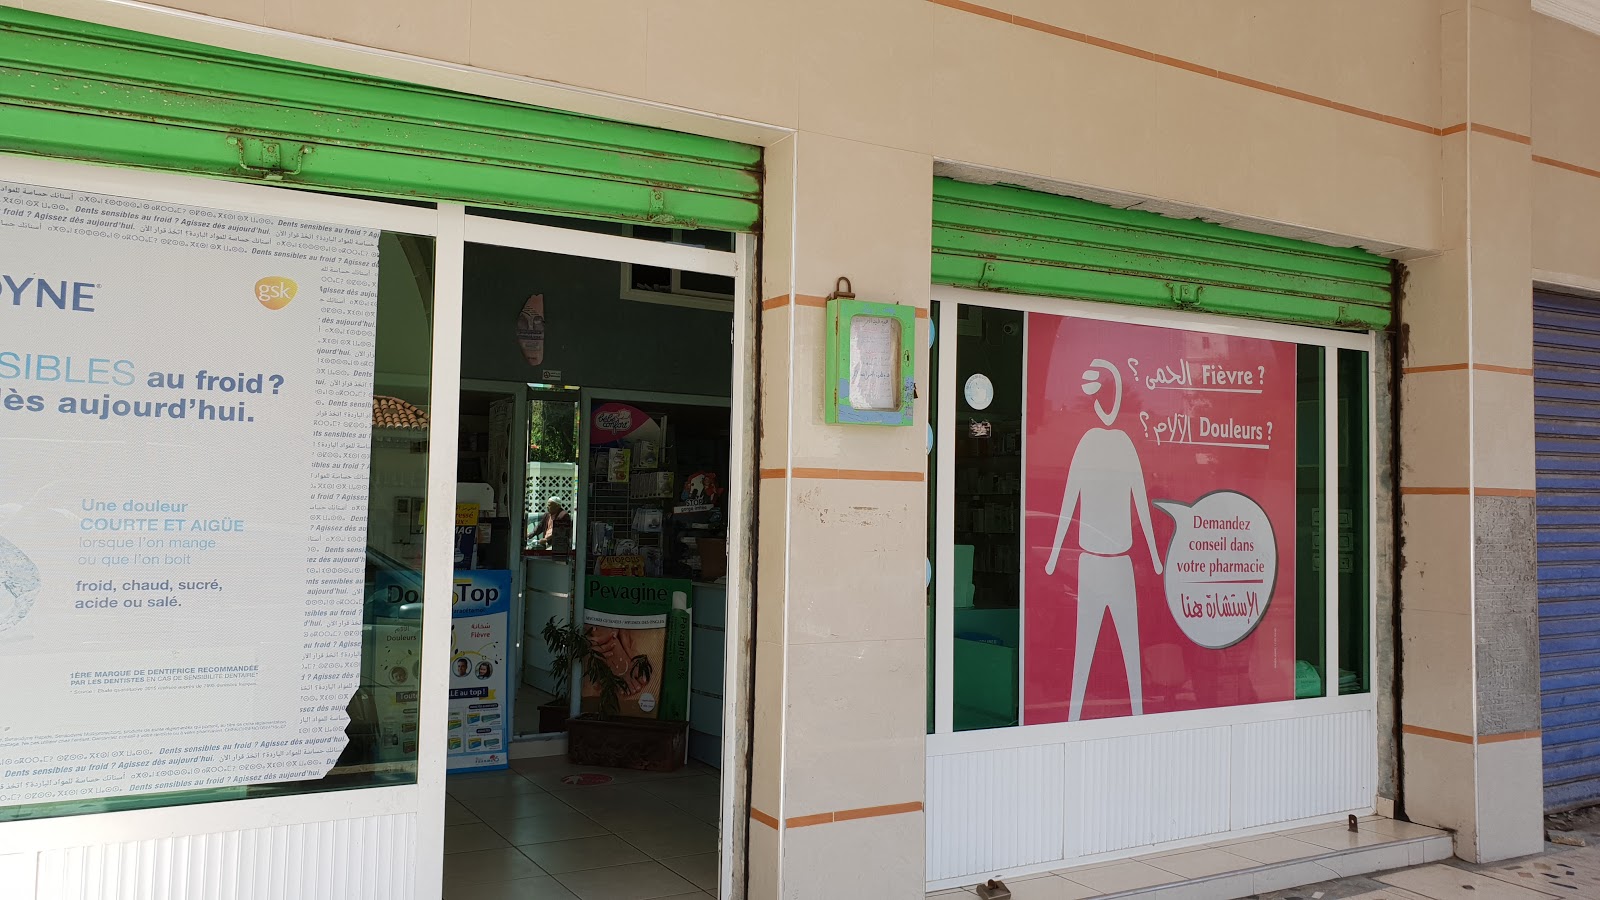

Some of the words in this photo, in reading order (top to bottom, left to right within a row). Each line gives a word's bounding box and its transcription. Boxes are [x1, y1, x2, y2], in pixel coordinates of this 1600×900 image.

[3, 208, 24, 217] froid
[34, 212, 67, 222] Agissez
[75, 205, 99, 215] Dents
[101, 210, 139, 220] sensibles
[153, 215, 173, 223] froid
[181, 218, 210, 228] Agissez
[277, 219, 298, 228] Dents
[300, 223, 333, 232] sensibles
[344, 228, 362, 236] froid
[252, 247, 272, 256] Dents
[273, 250, 307, 260] sensibles
[320, 255, 336, 263] froid
[344, 258, 370, 266] Agissez
[0, 275, 95, 312] YNE
[258, 282, 290, 302] gsk
[0, 351, 136, 387] SIBLES
[147, 371, 185, 389] au
[1202, 364, 1254, 385] Fièvre
[1257, 365, 1265, 385] ?
[0, 387, 45, 412] ès
[58, 394, 254, 422] aujourd'hui.
[1200, 416, 1264, 441] Douleurs
[1266, 421, 1273, 441] ?
[81, 499, 118, 512] Une
[122, 500, 188, 512] douleur
[80, 518, 159, 532] COURTE
[163, 519, 187, 531] ET
[190, 517, 244, 532] AIGÜE
[1193, 516, 1251, 530] Demandez
[79, 537, 134, 551] lorsque
[169, 539, 216, 550] mange
[1189, 537, 1228, 551] conseil
[1230, 537, 1254, 552] dans
[78, 556, 96, 566] ou
[101, 556, 130, 568] que
[164, 554, 192, 566] boit
[1177, 560, 1206, 573] votre
[1209, 558, 1265, 577] pharmacie
[76, 580, 117, 592] froid,
[122, 580, 174, 592] chaud,
[178, 578, 223, 592] sucré,
[590, 580, 668, 605] Pevagine
[74, 597, 118, 608] acide
[123, 600, 142, 608] ou
[147, 596, 182, 608] salé.
[456, 584, 499, 606] Top
[678, 616, 687, 662] Pevagine
[94, 670, 131, 678] MARQUE
[147, 668, 196, 676] DENTIFRICE
[184, 744, 220, 753] sensibles
[260, 740, 289, 748] Agissez
[5, 770, 30, 778] Dents
[32, 766, 73, 776] sensibles
[88, 763, 109, 771] froid
[118, 760, 150, 770] Agissez
[129, 784, 152, 792] Dents
[154, 779, 192, 789] sensibles
[206, 777, 225, 785] froid
[233, 775, 262, 783] Agissez
